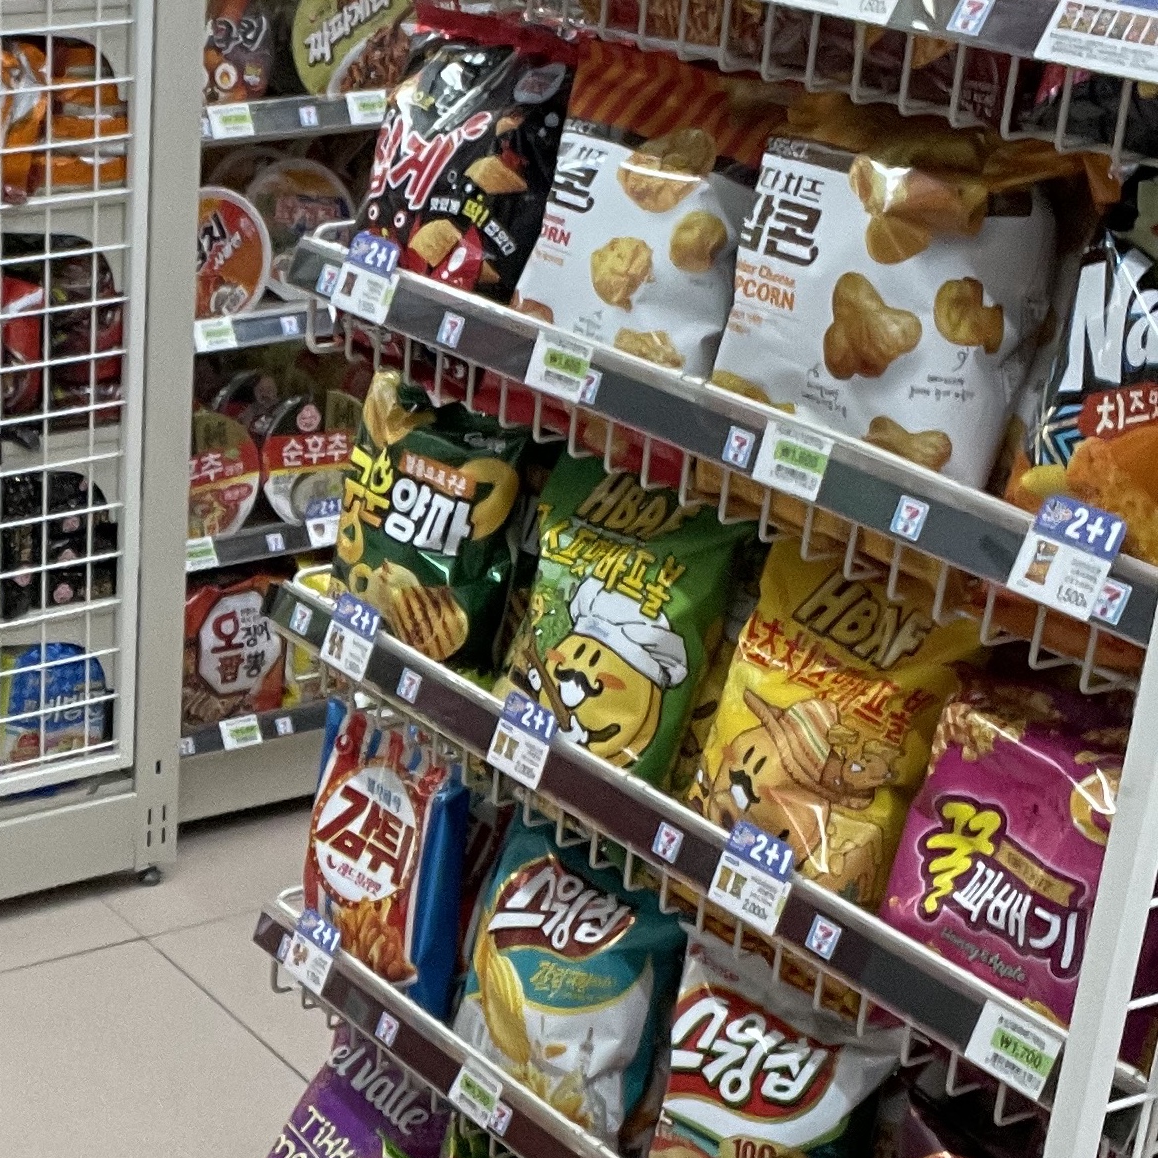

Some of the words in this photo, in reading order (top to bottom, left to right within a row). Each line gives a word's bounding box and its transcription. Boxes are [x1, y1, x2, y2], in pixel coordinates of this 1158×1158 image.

[364, 242, 397, 271] 2+1
[384, 477, 472, 556] 양파
[1065, 510, 1124, 550] 2+1
[351, 604, 379, 635] 2+1
[521, 702, 556, 734] 2+1
[749, 834, 793, 876] 2+1
[488, 866, 632, 951] 스윙칩
[952, 861, 1079, 970] 꽈배기
[311, 918, 341, 950] 2+1
[671, 997, 829, 1103] 스윙칩
